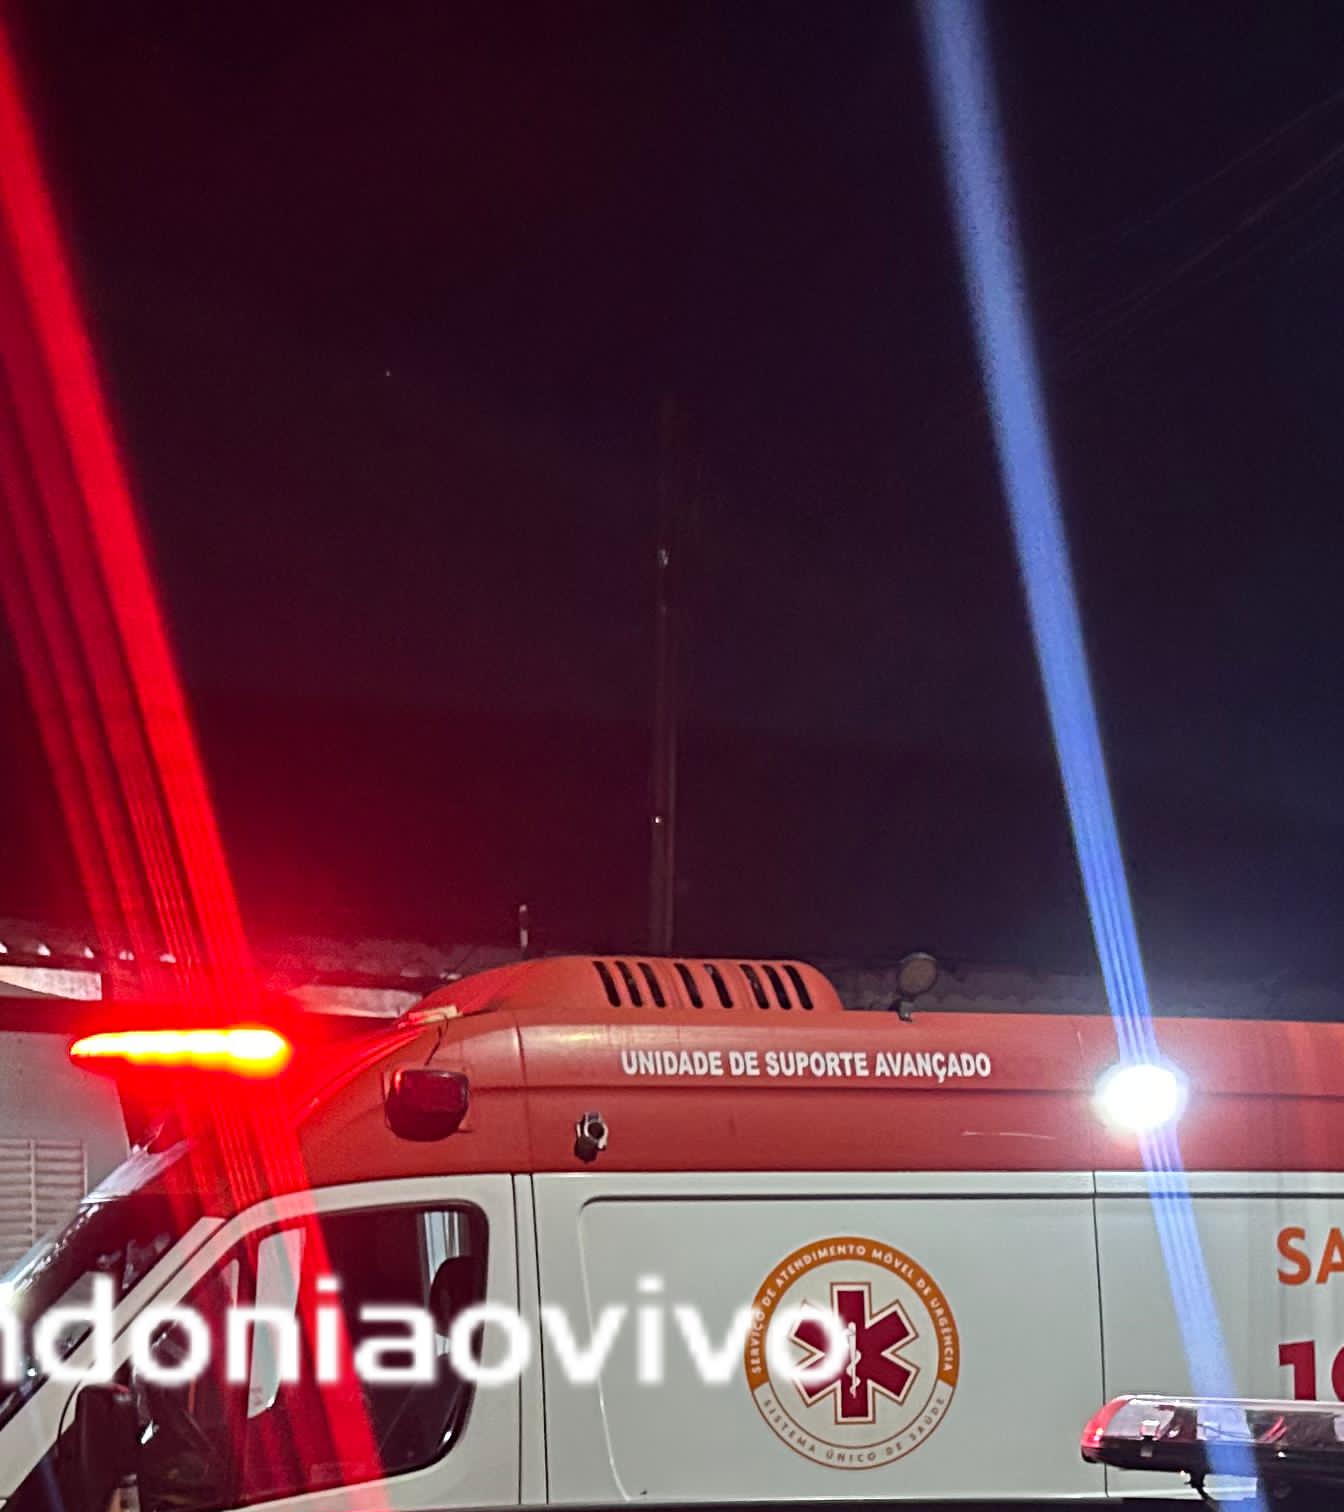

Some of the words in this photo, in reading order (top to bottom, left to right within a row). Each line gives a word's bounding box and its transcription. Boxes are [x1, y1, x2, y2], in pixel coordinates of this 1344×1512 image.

[621, 1049, 724, 1077] UNIDADE
[729, 1051, 761, 1077] DE
[766, 1051, 869, 1078] SUPORTE
[875, 1051, 992, 1083] AVANÇADO
[749, 1307, 766, 1375] SERVIÇO
[761, 1287, 777, 1308] DE
[775, 1244, 867, 1288] ATENDIMENTO
[871, 1248, 914, 1279] MÓVEL
[916, 1278, 932, 1297] DE
[929, 1297, 954, 1373] URGÊNCIA
[763, 1399, 816, 1454] SISTEMA
[825, 1448, 877, 1463] ÚNICO
[885, 1441, 903, 1457] DE
[910, 1397, 945, 1442] SAÚDE
